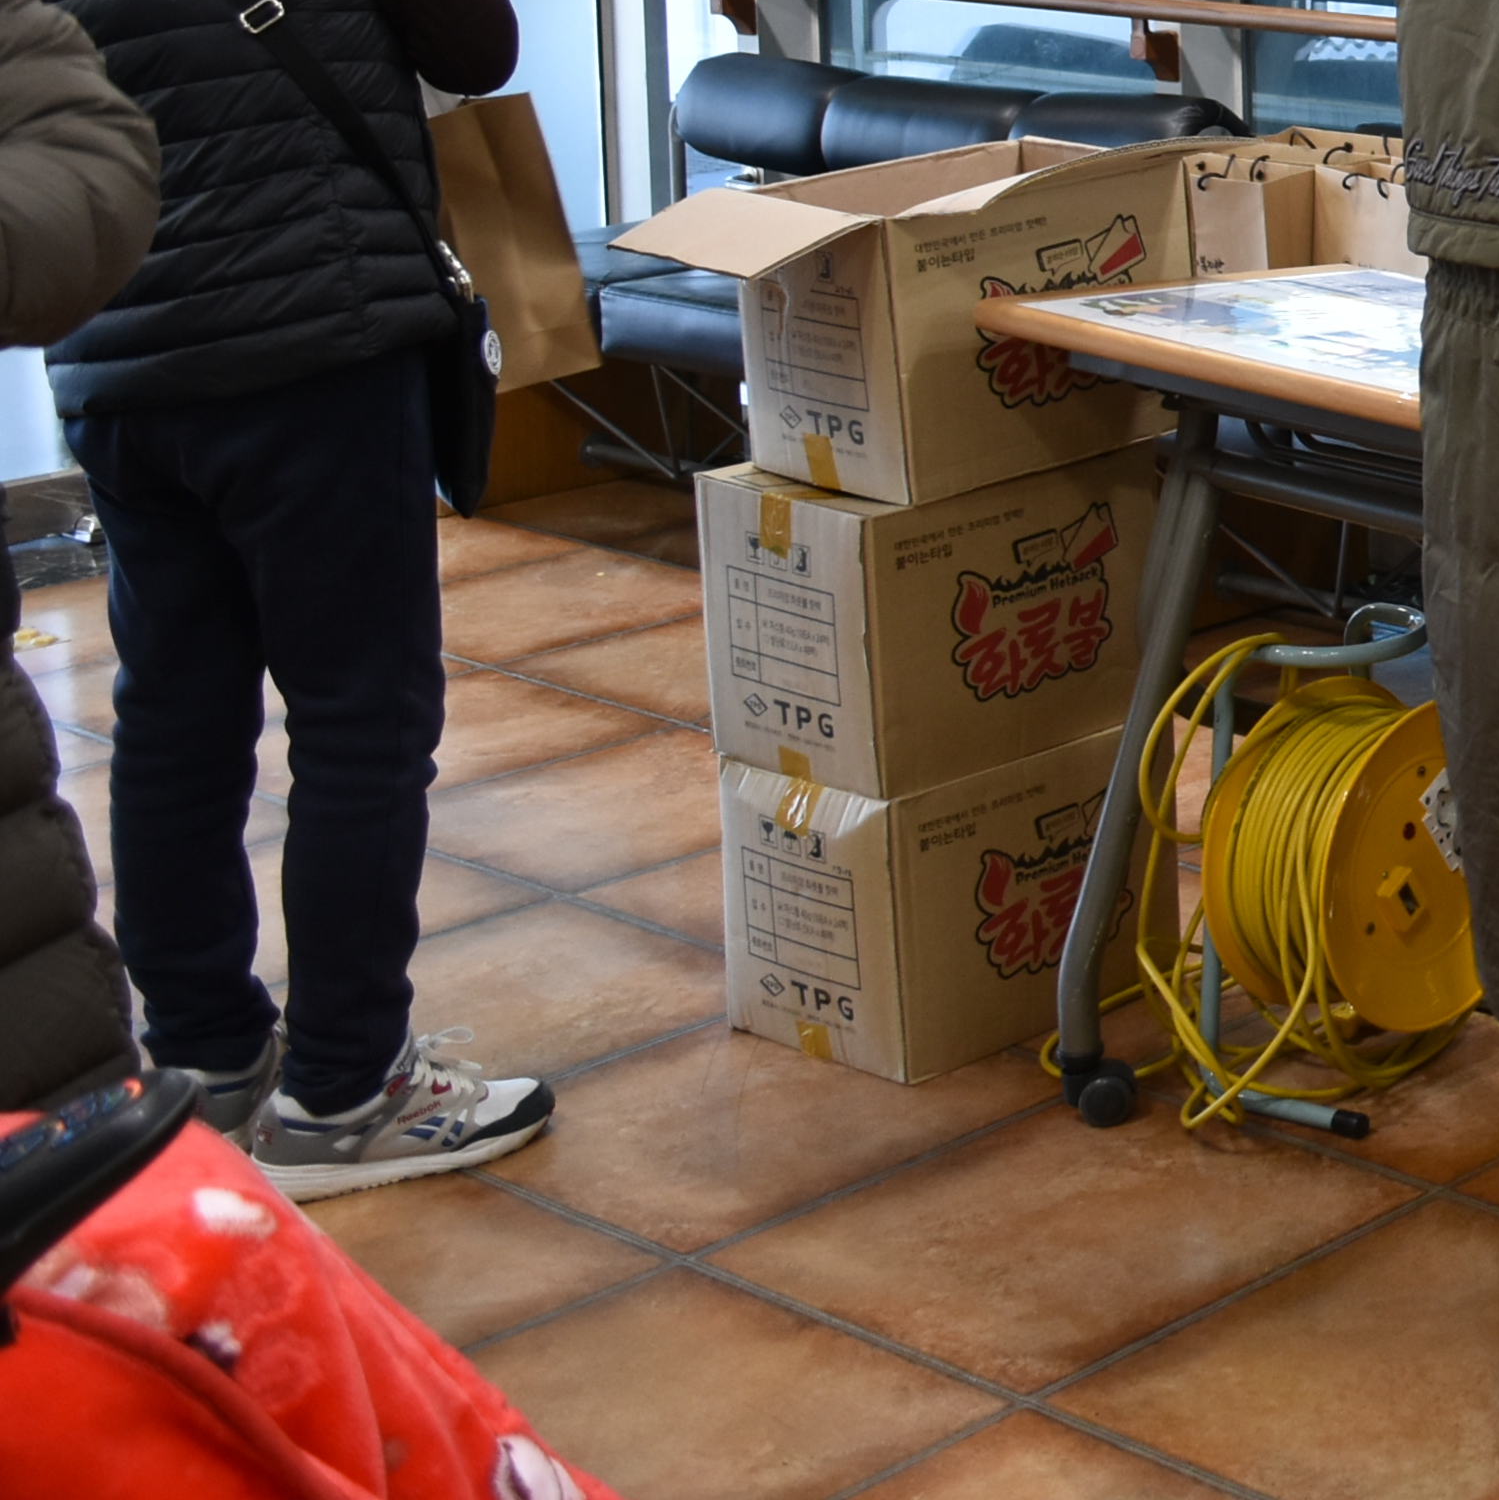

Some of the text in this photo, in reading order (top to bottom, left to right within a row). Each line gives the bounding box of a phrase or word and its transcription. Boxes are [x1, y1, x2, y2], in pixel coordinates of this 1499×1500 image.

[914, 236, 967, 254] 대한민국에서
[806, 409, 866, 446] TPG
[992, 565, 1099, 609] Premium Hotpack
[773, 699, 835, 739] TPG
[1015, 859, 1070, 886] Premium
[791, 980, 855, 1022] TPG
